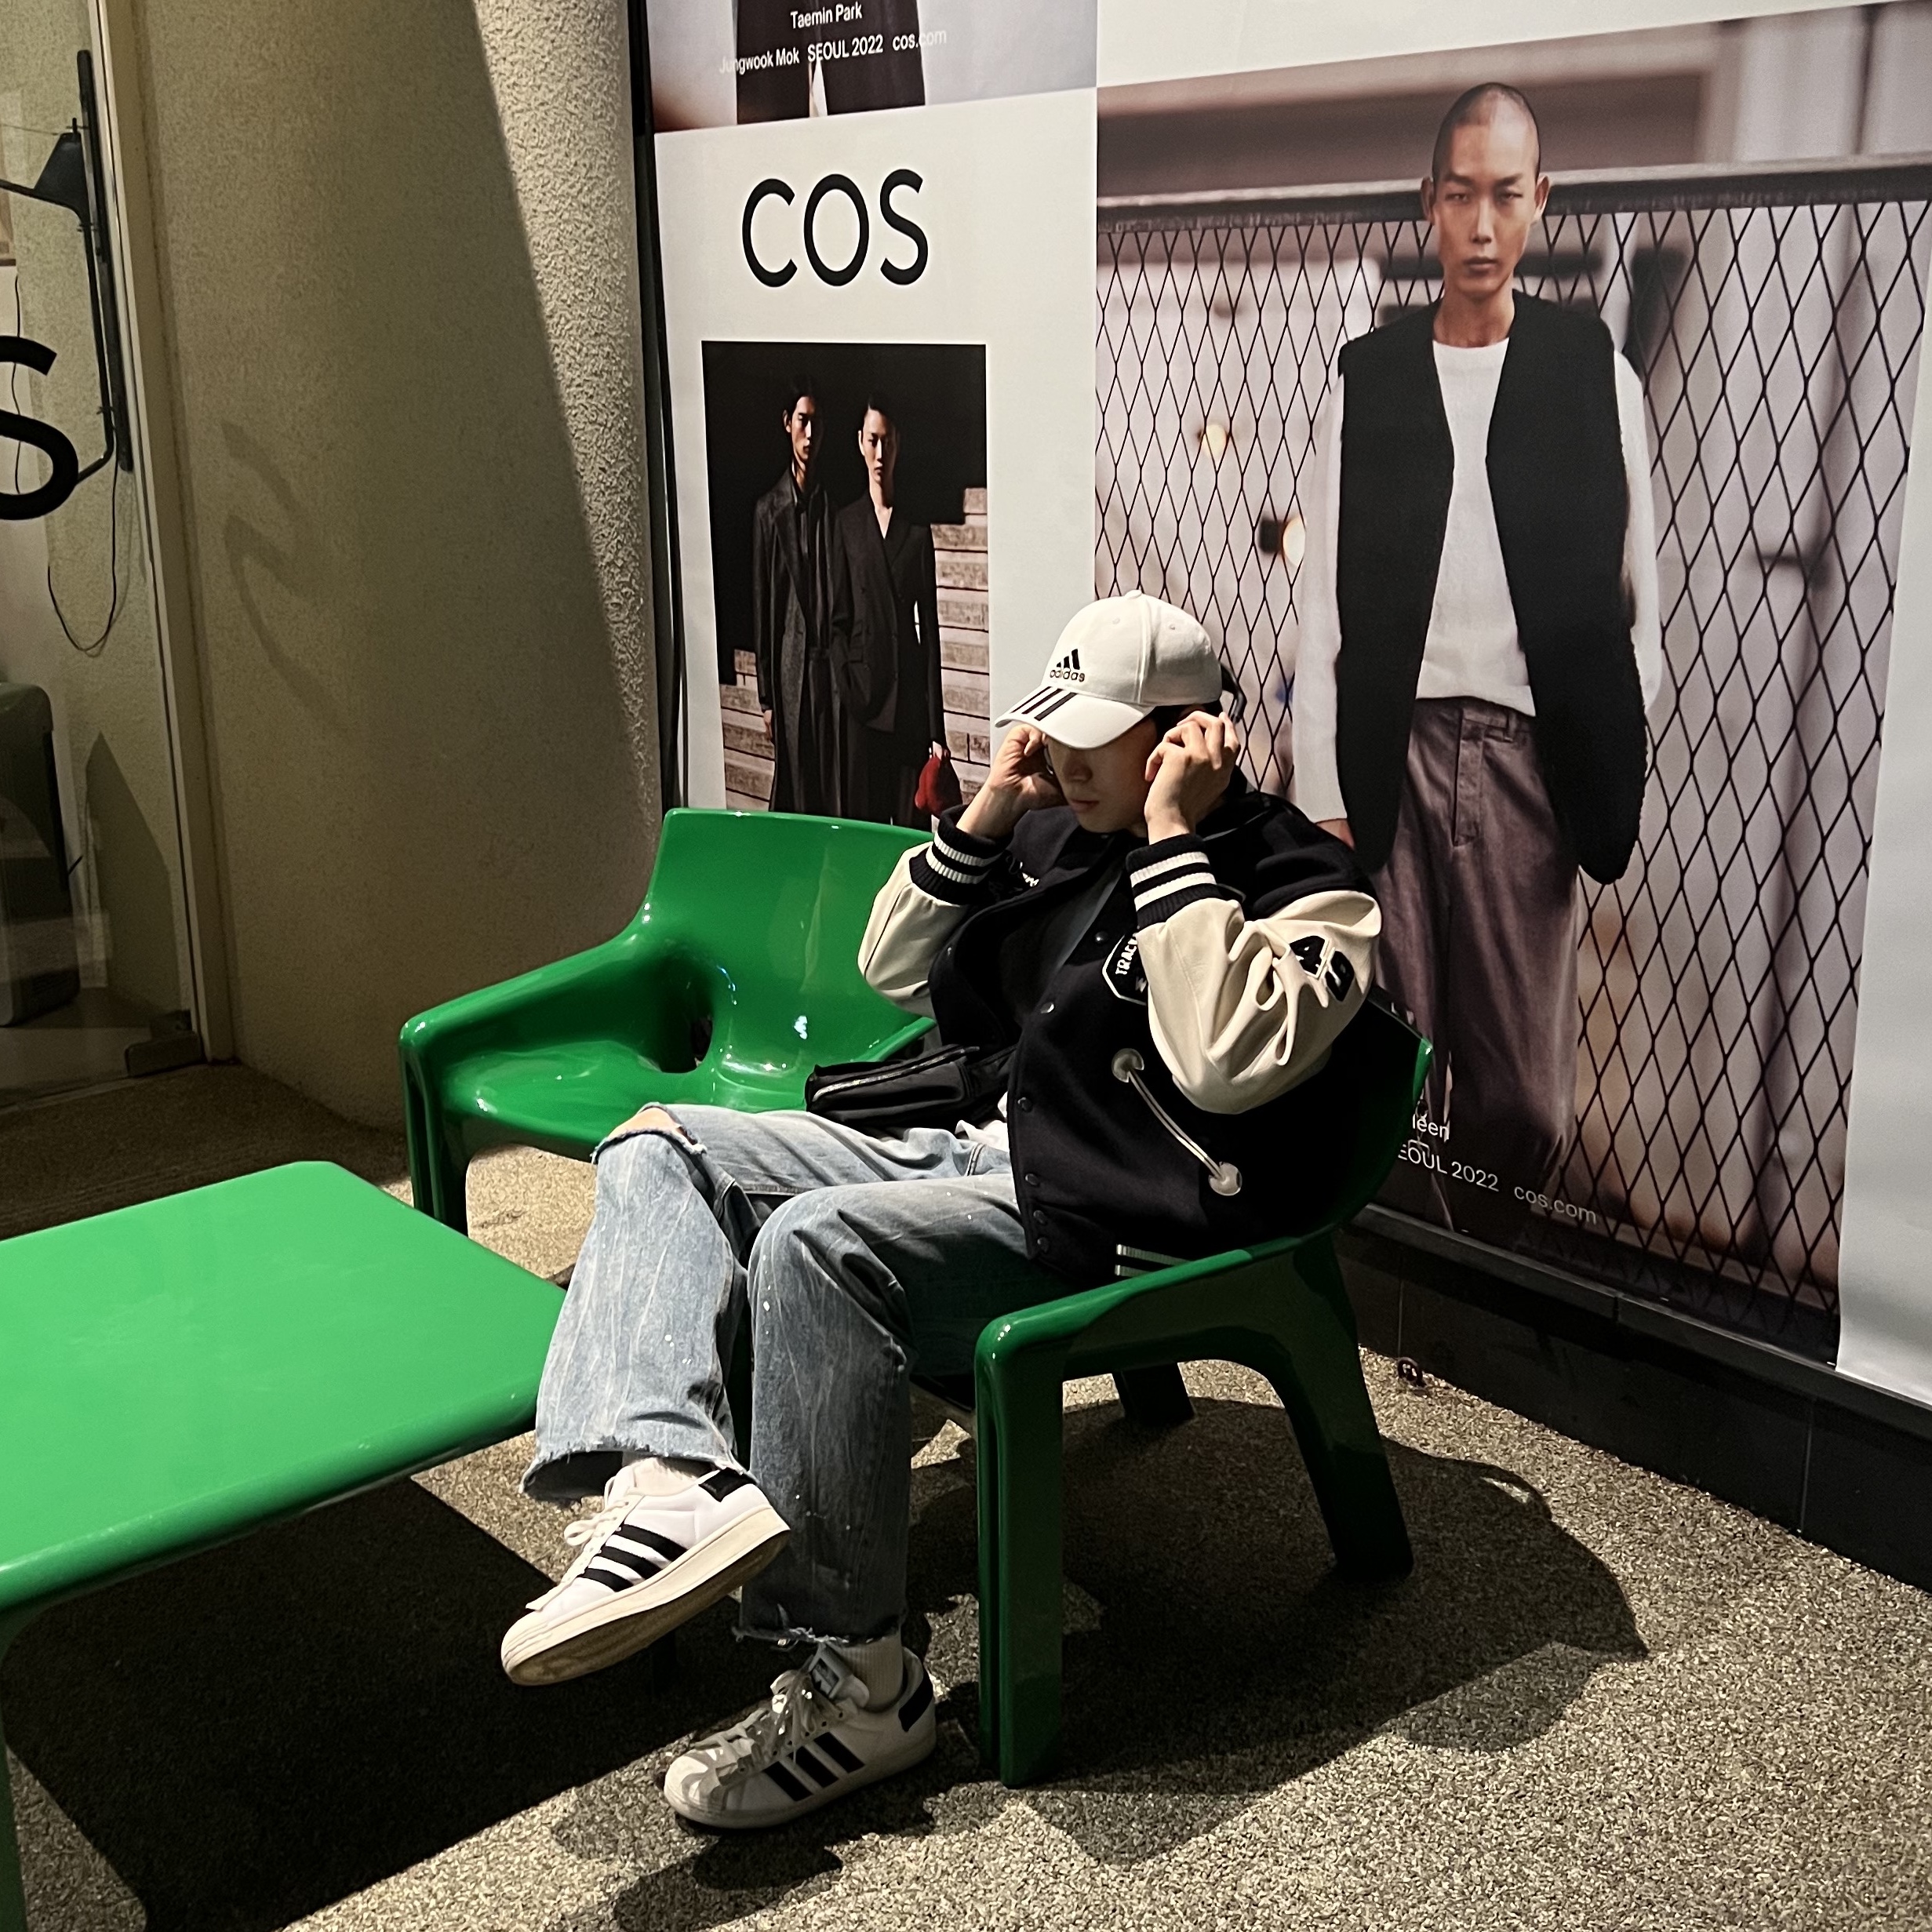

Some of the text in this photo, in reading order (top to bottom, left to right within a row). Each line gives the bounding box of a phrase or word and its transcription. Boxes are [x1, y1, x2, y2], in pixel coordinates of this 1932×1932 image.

[790, 2, 863, 29] Taemin Park
[719, 30, 947, 76] Jungwook Mok SEOUL 2022 cos.com
[742, 169, 929, 287] COS
[1050, 668, 1085, 682] adidas
[1412, 1113, 1450, 1141] leen
[1398, 1144, 1597, 1225] EOUL 2022 cos.com
